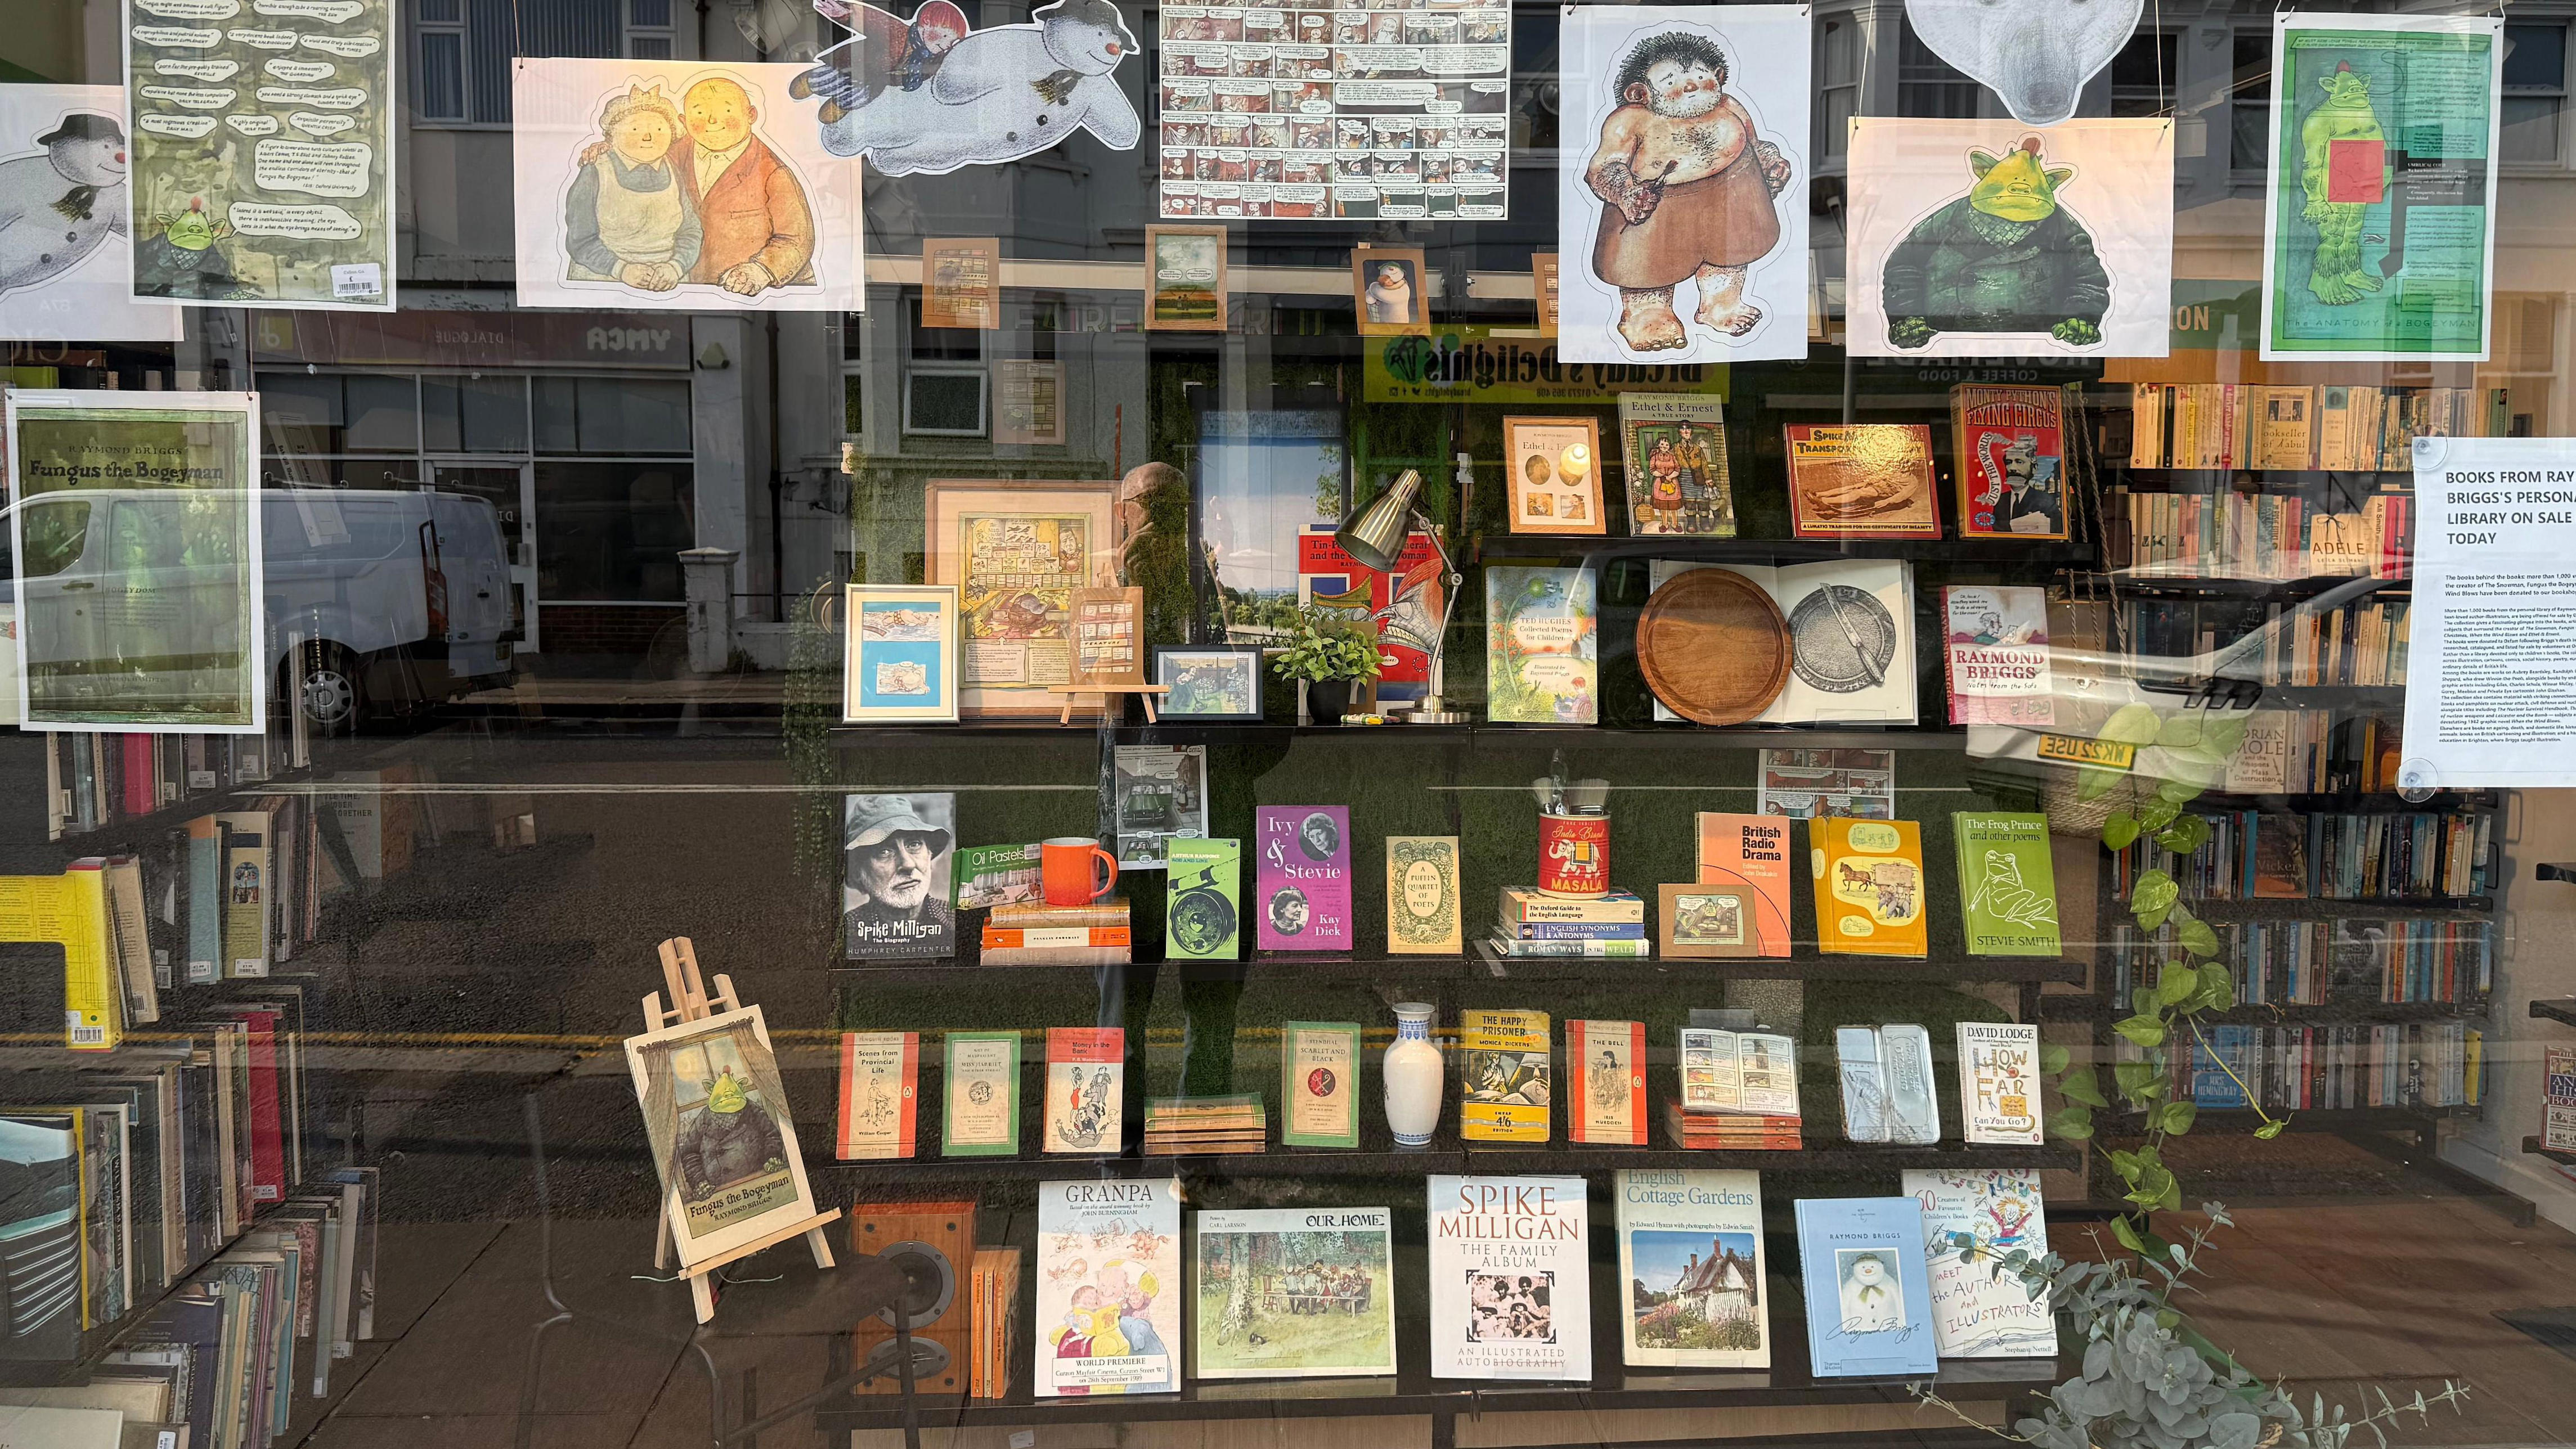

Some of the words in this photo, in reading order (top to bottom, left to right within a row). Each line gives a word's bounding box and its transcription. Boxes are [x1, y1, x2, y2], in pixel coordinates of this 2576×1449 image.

[2406, 319, 2475, 327] BOGEYMAN
[1632, 402, 1661, 411] Ethel
[1665, 403, 1673, 411] &
[1679, 403, 1714, 412] Ernest
[1966, 387, 2004, 411] MONTY
[2006, 389, 2056, 414] PYTHON'S
[1966, 403, 2011, 426] FLYING
[2013, 403, 2057, 428] CIRCUS
[135, 447, 182, 455] BRIGGS
[30, 460, 101, 485] Fungus
[104, 461, 132, 478] the
[134, 461, 223, 484] Bogeyman
[2446, 471, 2495, 484] BOOKS
[2501, 471, 2541, 483] FROM
[2547, 471, 2574, 483] RAY
[2447, 491, 2512, 504] BRIGGS'S
[2517, 490, 2576, 503] PERSON
[2448, 512, 2506, 524] LIBRARY
[2511, 512, 2533, 524] ON
[2538, 512, 2572, 524] SALE
[2447, 532, 2497, 545] TODAY
[1955, 650, 2045, 664] RAYMOND
[1967, 666, 2036, 679] BRIGGS
[1267, 817, 1295, 836] Ivy
[1742, 826, 1781, 838] British
[1966, 820, 1986, 830] The
[1988, 820, 2009, 832] Frog
[2011, 820, 2042, 831] Prince
[1742, 837, 1775, 849] Radio
[1970, 831, 1987, 840] and
[1990, 831, 2010, 840] other
[2013, 833, 2040, 843] poems
[972, 850, 985, 866] Oil
[990, 848, 1024, 863] Pastels
[1267, 838, 1287, 867] &
[1742, 849, 1781, 861] Drama
[1285, 863, 1340, 879] Stevie
[1551, 878, 1603, 892] MASALA
[1319, 914, 1340, 928] Kay
[858, 921, 888, 941] Spike
[893, 920, 941, 938] Milligan
[1315, 924, 1340, 936] Dick
[1977, 936, 2016, 946] STEVIE
[2018, 936, 2055, 947] SMITH
[1483, 1016, 1497, 1024] THE
[1501, 1016, 1527, 1026] HAPPY
[1483, 1027, 1526, 1036] PRISONER
[1967, 1027, 1998, 1038] DAVID
[2000, 1028, 2034, 1039] LODGE
[1973, 1047, 2027, 1077] HOW
[1627, 1169, 1685, 1188] English
[690, 1199, 724, 1217] Fungus
[726, 1193, 742, 1204] the
[742, 1177, 789, 1199] Bogeyman
[1066, 1185, 1153, 1202] GRANPA
[1460, 1185, 1556, 1216] SPIKE
[1627, 1186, 1685, 1207] Cottage
[1688, 1187, 1753, 1205] Gardens
[1306, 1215, 1340, 1227] OUR
[1341, 1214, 1385, 1226] HOME
[1439, 1216, 1579, 1241] MILLIGAN
[1460, 1243, 1493, 1256] THE
[1501, 1244, 1558, 1257] FAMILY
[1482, 1256, 1537, 1268] ALBUM
[1935, 1266, 1962, 1282] MEET
[1932, 1288, 1950, 1303] the
[1953, 1272, 2021, 1298] AUTHORS
[1960, 1297, 1979, 1309] and
[1946, 1302, 2043, 1334] ILLUSTRATORS
[1458, 1348, 1474, 1357] AN
[1477, 1347, 1564, 1357] ILLUSTRATED
[1457, 1357, 1566, 1369] AUTOBIOGRAPHY
